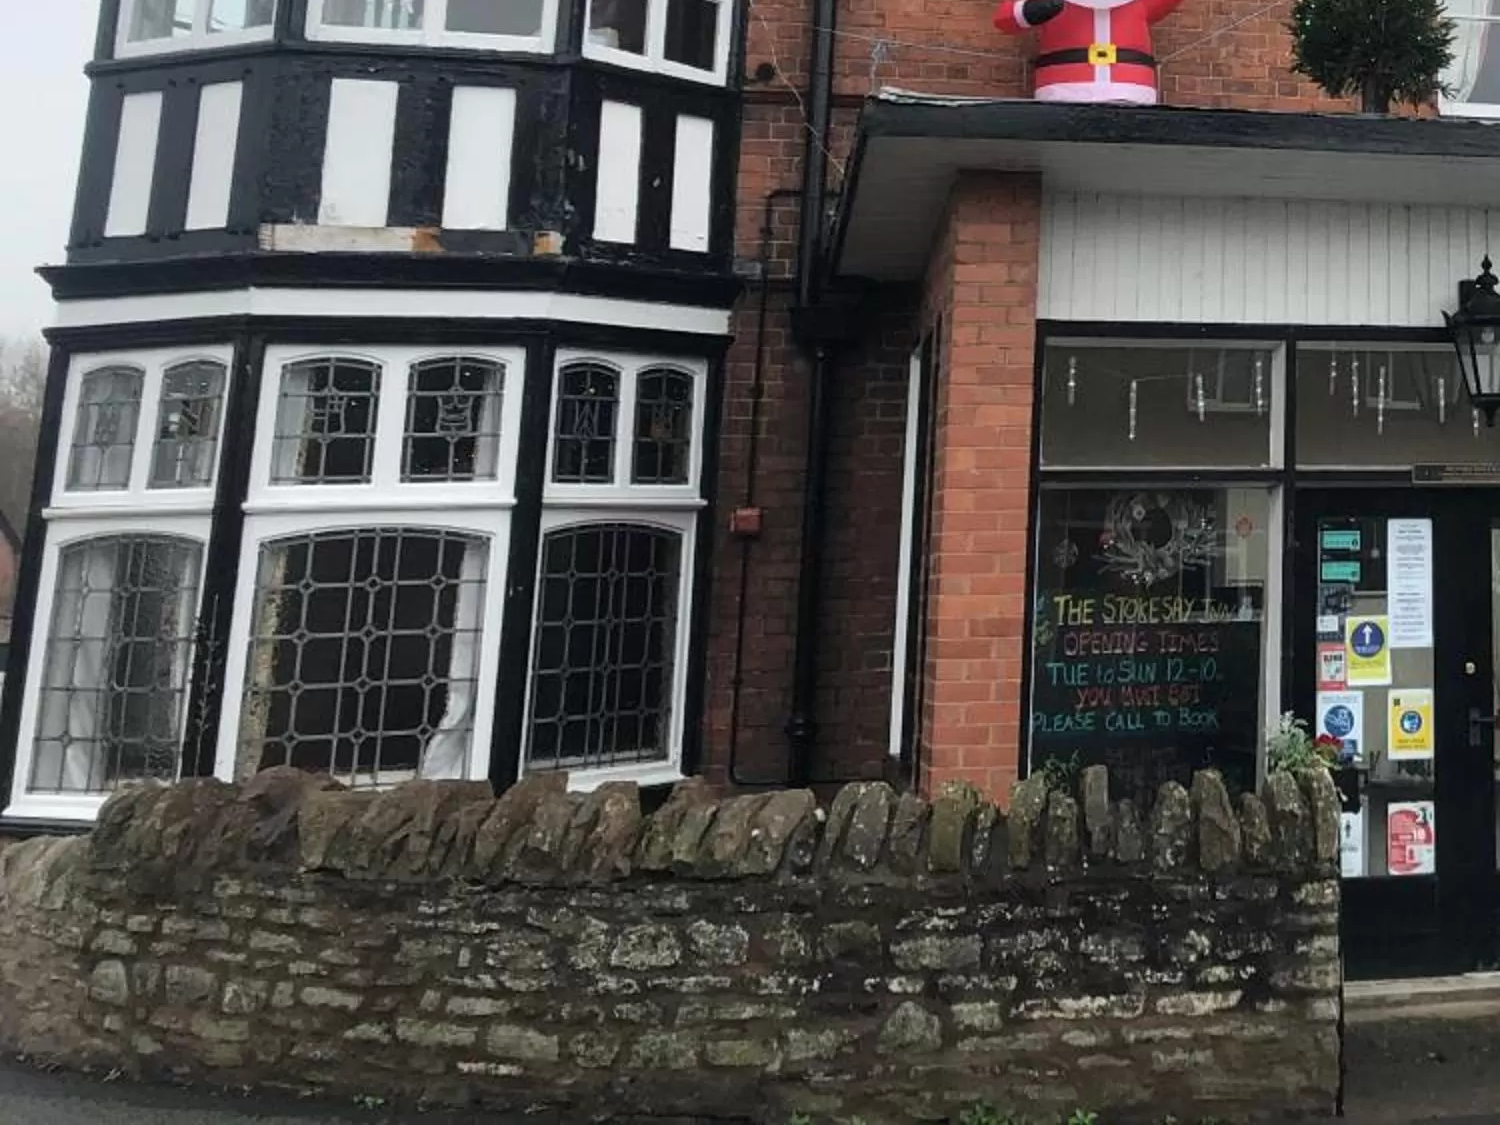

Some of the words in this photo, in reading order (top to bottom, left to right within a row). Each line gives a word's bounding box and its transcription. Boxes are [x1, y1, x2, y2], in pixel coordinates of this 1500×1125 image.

[1053, 593, 1096, 625] THE
[1102, 593, 1196, 623] STOKESAY
[1063, 629, 1149, 656] OPENING
[1157, 630, 1220, 653] TIMES
[1045, 662, 1090, 686] TUE
[1117, 659, 1157, 683] SUN
[1075, 687, 1112, 711] YOU
[1033, 711, 1096, 732] PLEASE
[1105, 711, 1145, 732] CALL
[1153, 710, 1172, 727] TO
